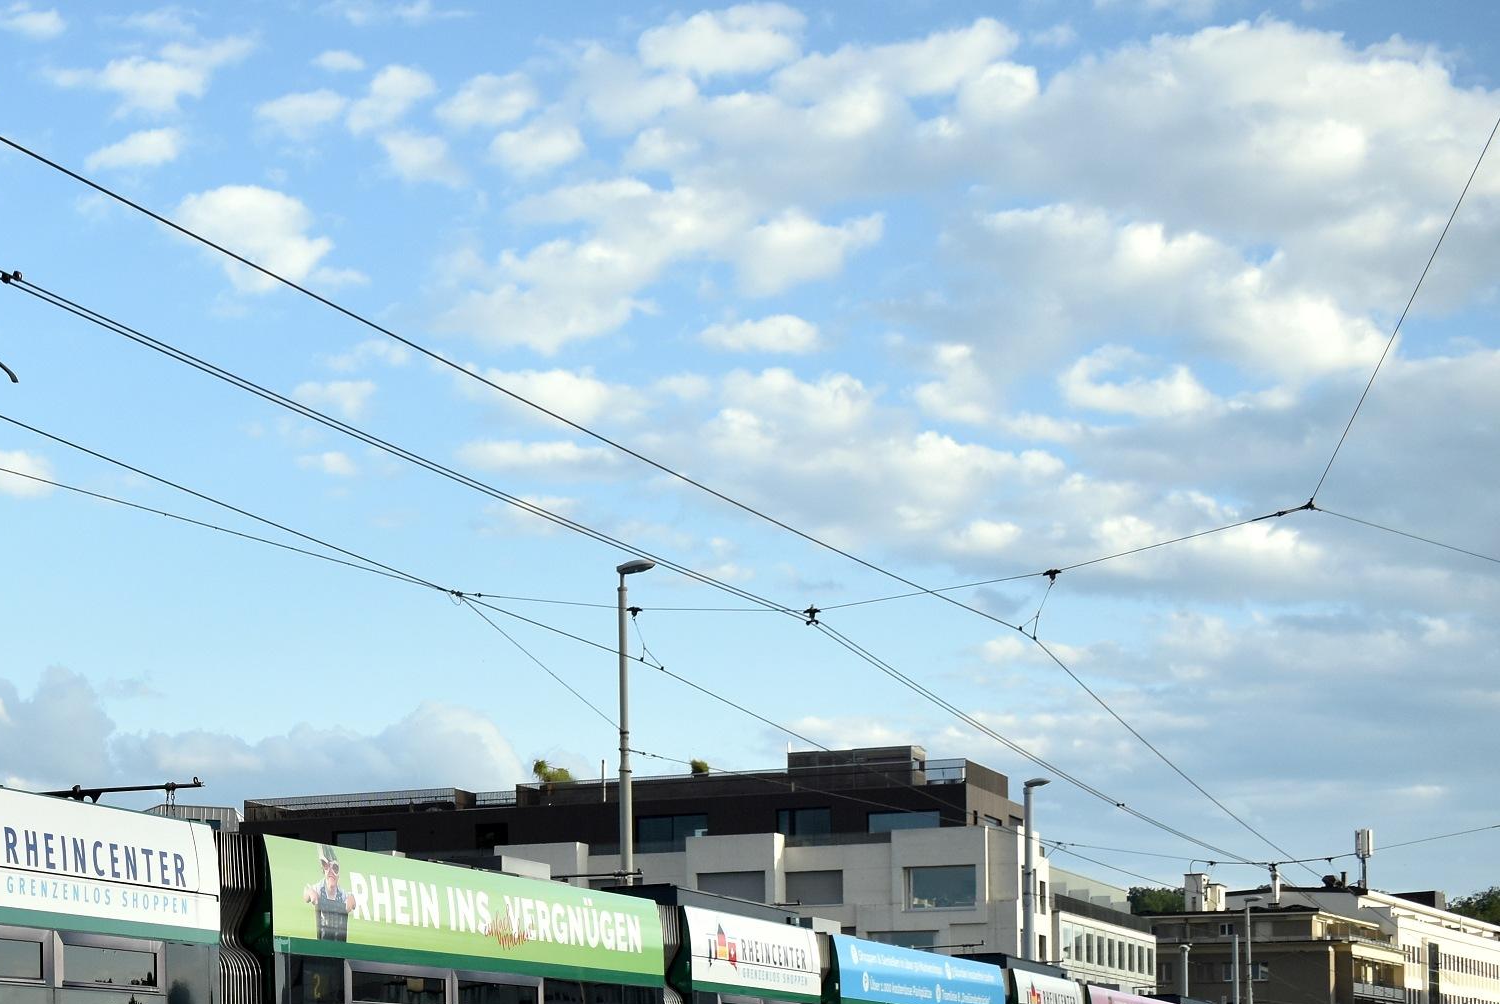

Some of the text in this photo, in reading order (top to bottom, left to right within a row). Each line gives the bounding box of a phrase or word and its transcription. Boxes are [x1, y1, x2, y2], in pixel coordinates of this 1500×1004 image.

[4, 826, 187, 888] RHEINCENTER
[7, 876, 187, 915] GRENZENLOS SHOPPEN
[349, 871, 643, 953] RHEIN INS VERGNÜGEN
[741, 938, 807, 970] RHEINCENTER
